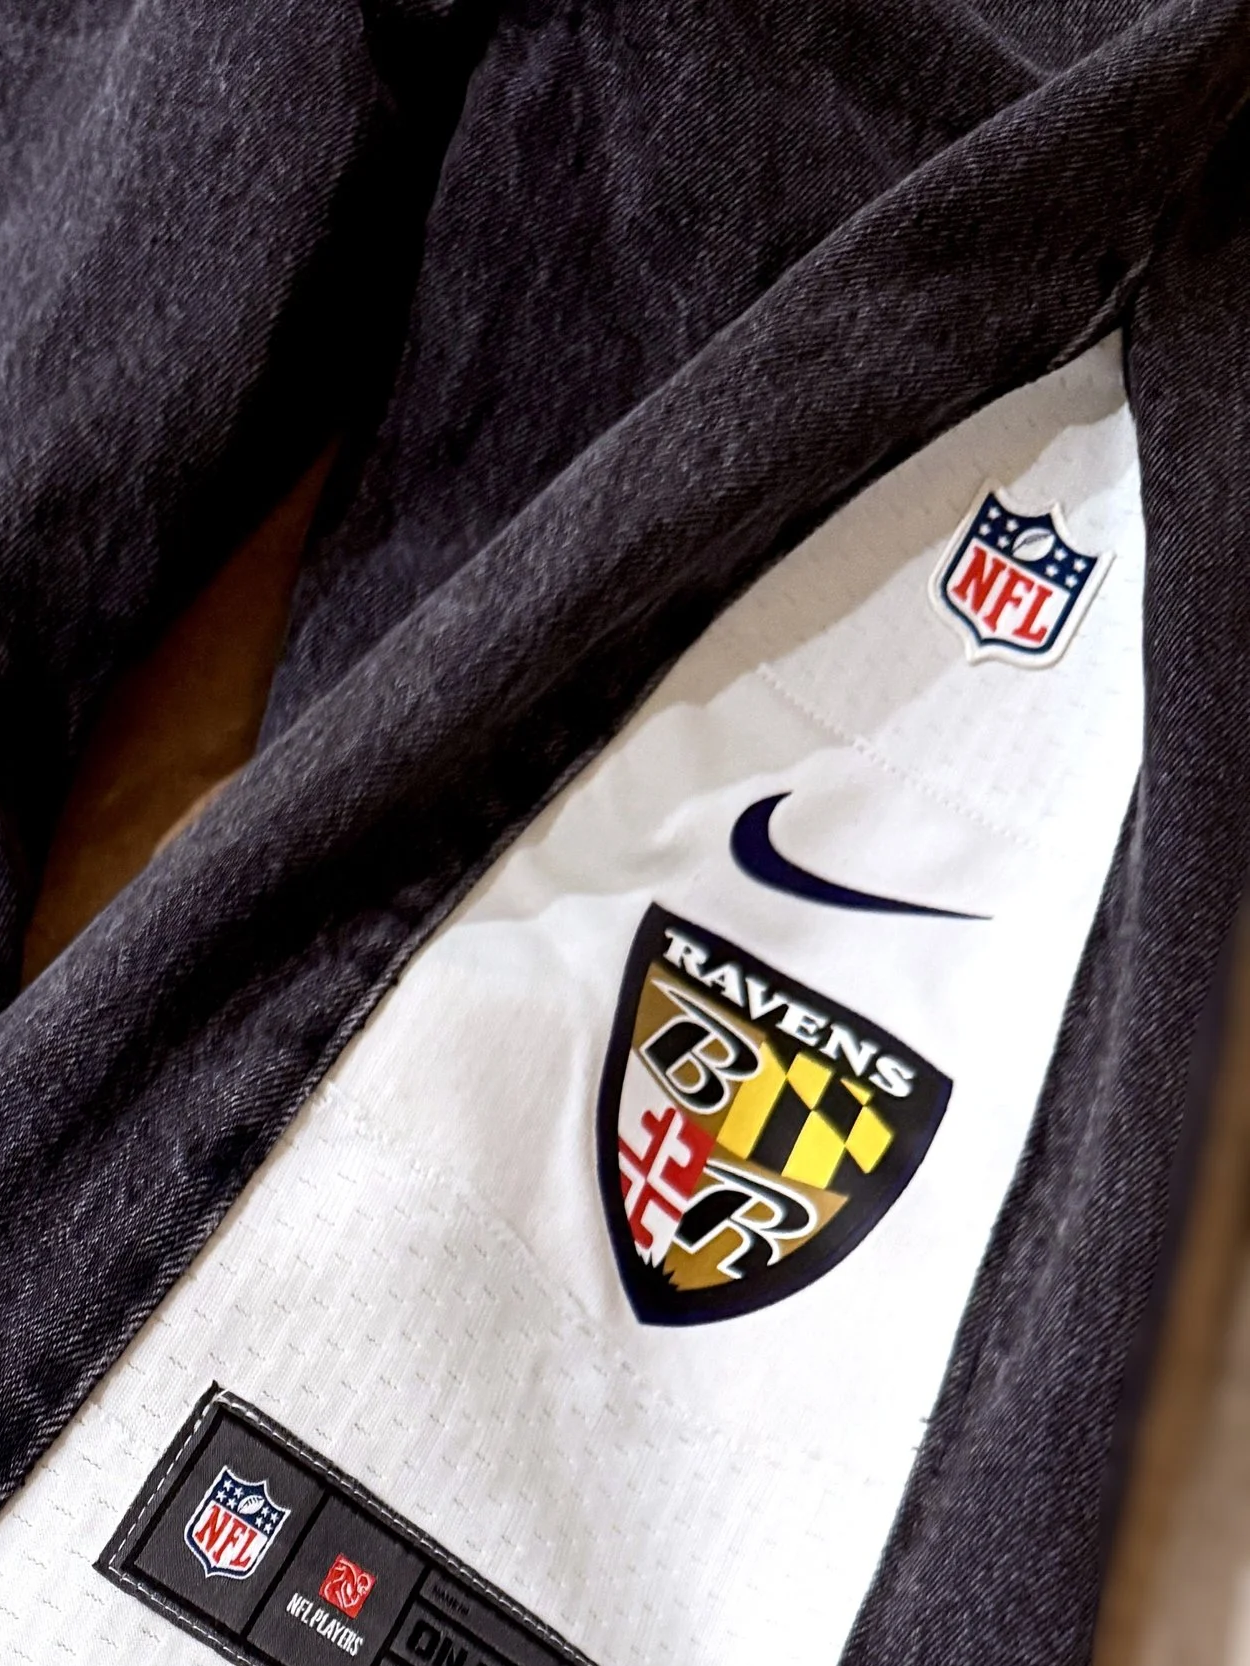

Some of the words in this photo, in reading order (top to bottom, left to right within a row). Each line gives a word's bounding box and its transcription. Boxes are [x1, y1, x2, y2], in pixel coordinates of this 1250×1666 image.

[951, 545, 1053, 643] NFL
[660, 926, 918, 1099] RAVENS
[193, 1503, 259, 1570] NFL
[286, 1592, 310, 1624] NFL
[309, 1609, 365, 1657] PLAYERS
